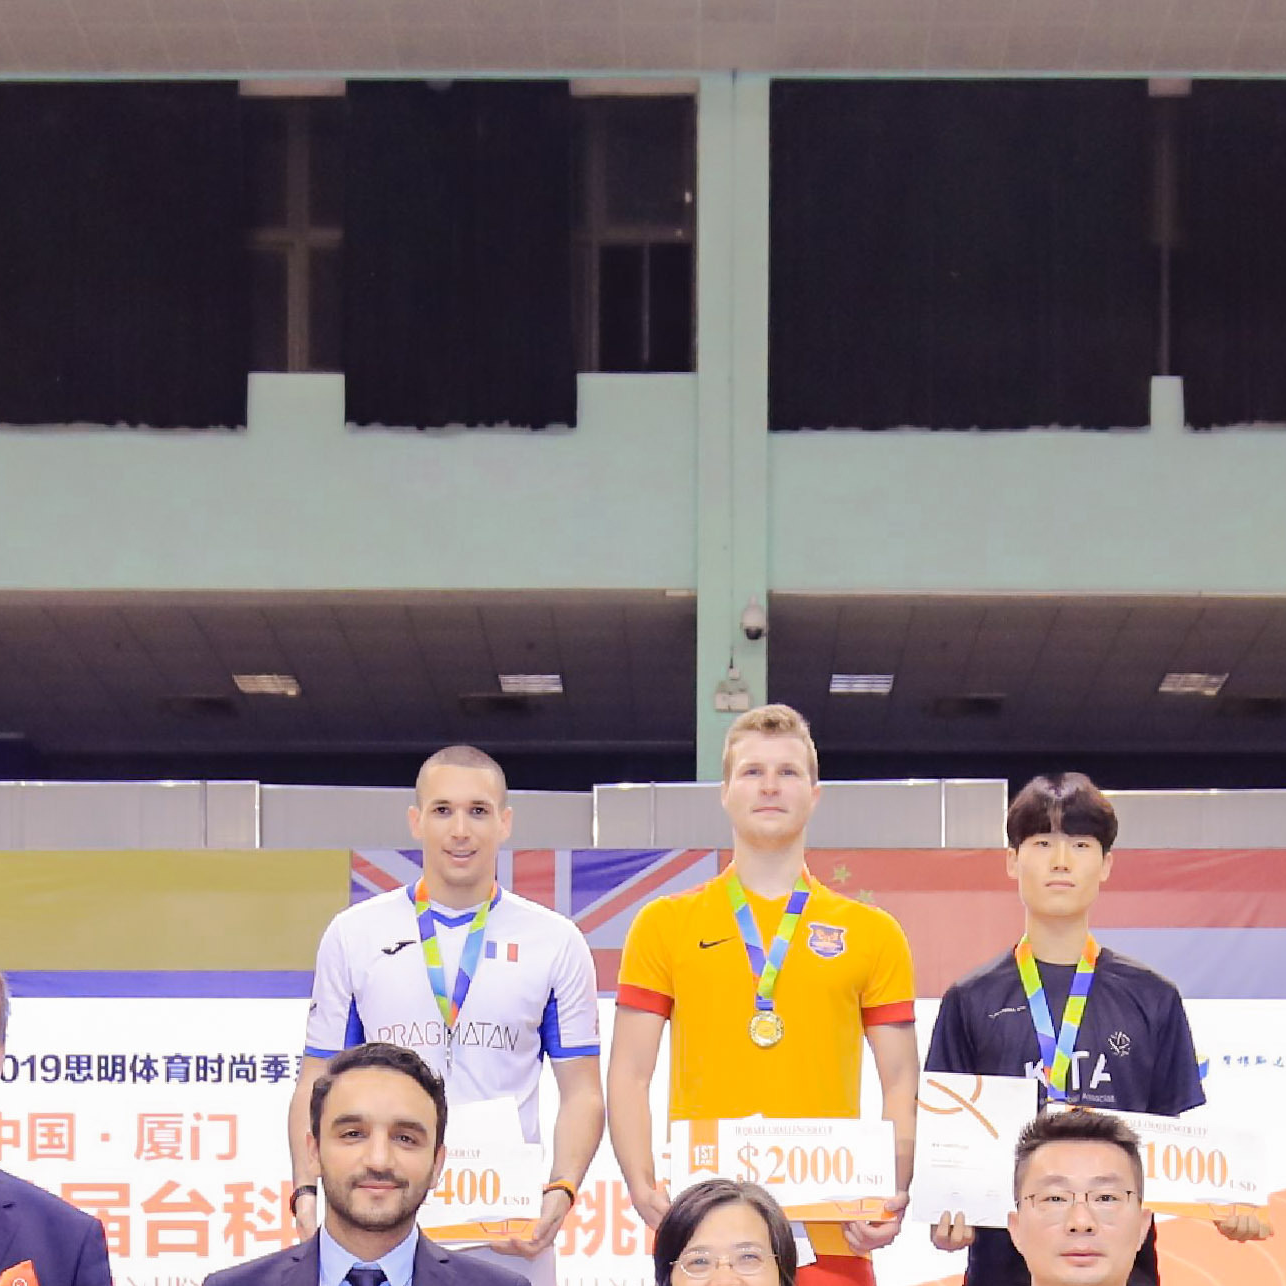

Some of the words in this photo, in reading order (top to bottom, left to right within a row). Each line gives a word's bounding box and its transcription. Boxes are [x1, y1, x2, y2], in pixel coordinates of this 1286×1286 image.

[378, 1021, 519, 1050] PRAGMATAN
[1, 1054, 301, 1083] 019思明体育时尚季
